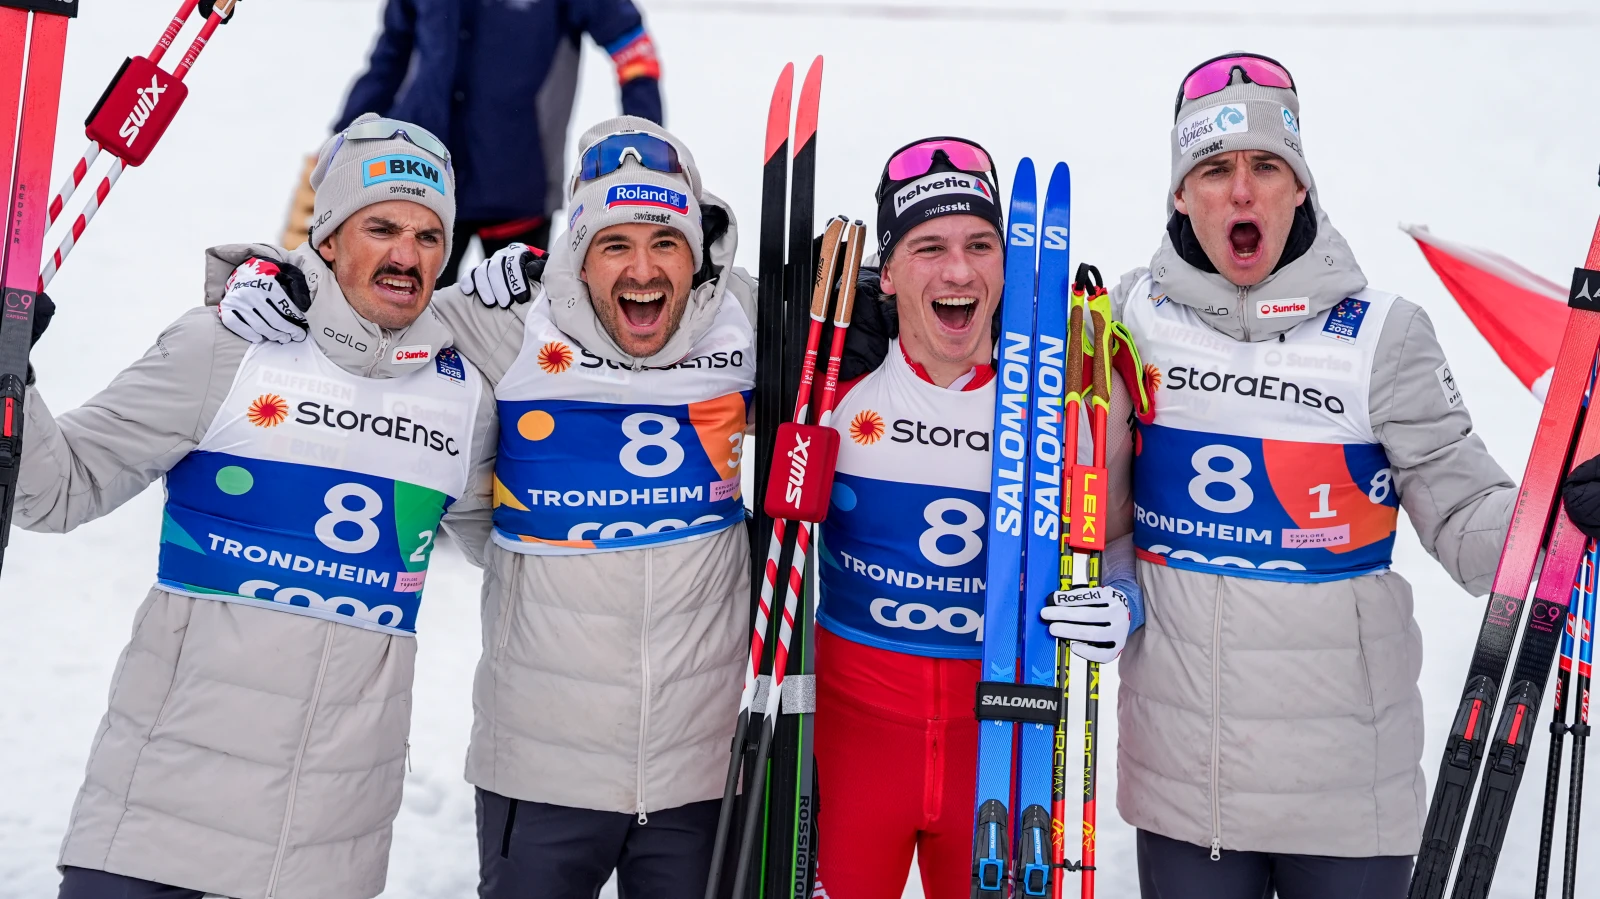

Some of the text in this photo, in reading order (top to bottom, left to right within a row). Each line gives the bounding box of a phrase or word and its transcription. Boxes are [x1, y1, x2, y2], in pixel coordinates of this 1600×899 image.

[1180, 122, 1214, 148] Spiess
[390, 160, 439, 183] BKW
[616, 187, 668, 202] Roland
[897, 176, 970, 208] helvetia
[14, 184, 26, 244] REDSTER
[924, 202, 970, 218] swissski
[6, 292, 32, 310] C9
[1272, 306, 1306, 314] Sunrise
[323, 326, 368, 353] odlo
[1328, 325, 1353, 336] 2025
[404, 350, 428, 360] Sunrise
[440, 366, 462, 378] 2025
[1166, 366, 1345, 414] StoraEnso
[618, 412, 684, 478] 8
[996, 332, 1030, 536] SALOMON
[1034, 335, 1064, 540] SALOMON
[727, 432, 742, 469] 3
[1188, 444, 1254, 514] 8
[1368, 468, 1392, 504] 8
[528, 486, 702, 506] TRONDHEIM
[1082, 474, 1098, 542] LEKI
[1308, 484, 1337, 519] 1
[315, 482, 383, 554] 8
[410, 530, 433, 562] 2
[918, 498, 986, 567] 8
[208, 533, 390, 588] TRONDHEIM
[1057, 590, 1102, 604] Roeckl
[1490, 597, 1517, 616] C9
[1532, 602, 1560, 622] C9
[1530, 624, 1552, 632] CARBON
[982, 695, 1058, 711] SALOMON
